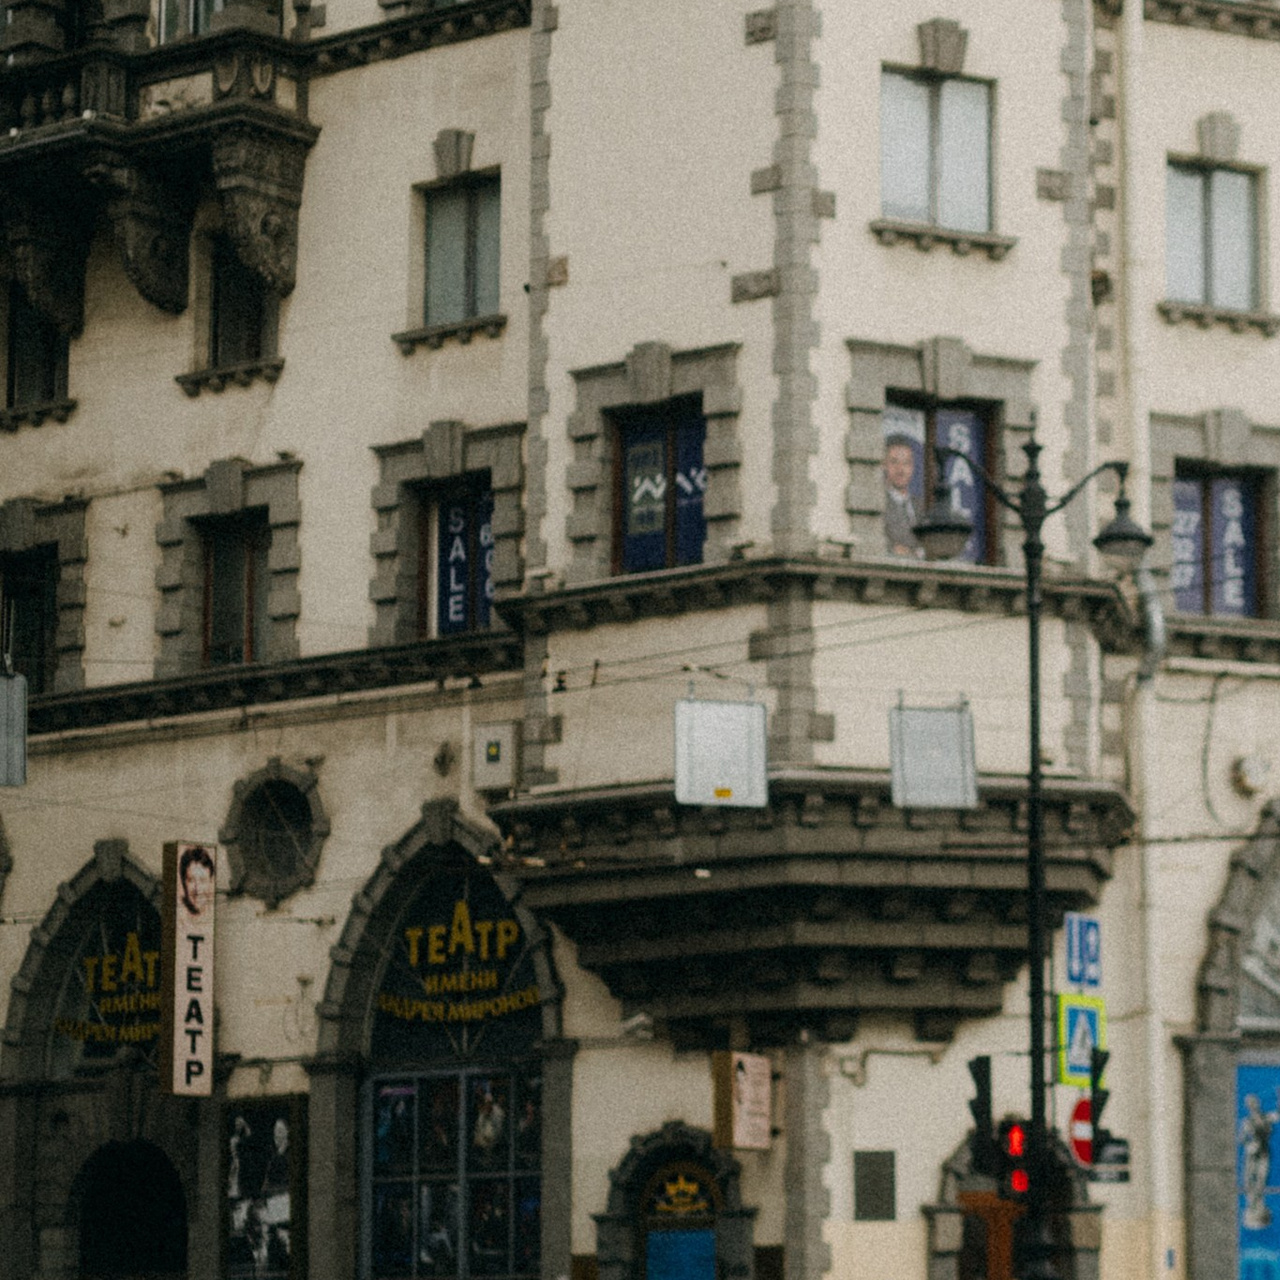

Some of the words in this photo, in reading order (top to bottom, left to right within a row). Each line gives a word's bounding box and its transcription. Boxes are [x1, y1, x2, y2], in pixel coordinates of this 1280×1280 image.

[949, 423, 974, 522] SAL
[448, 506, 467, 623] SALE
[1221, 488, 1246, 608] SALE
[82, 931, 161, 995] ТЕАТ
[404, 899, 520, 968] ТЕАТР
[423, 970, 499, 996] ИМЕНИ
[185, 934, 206, 1086] ТЕАТР
